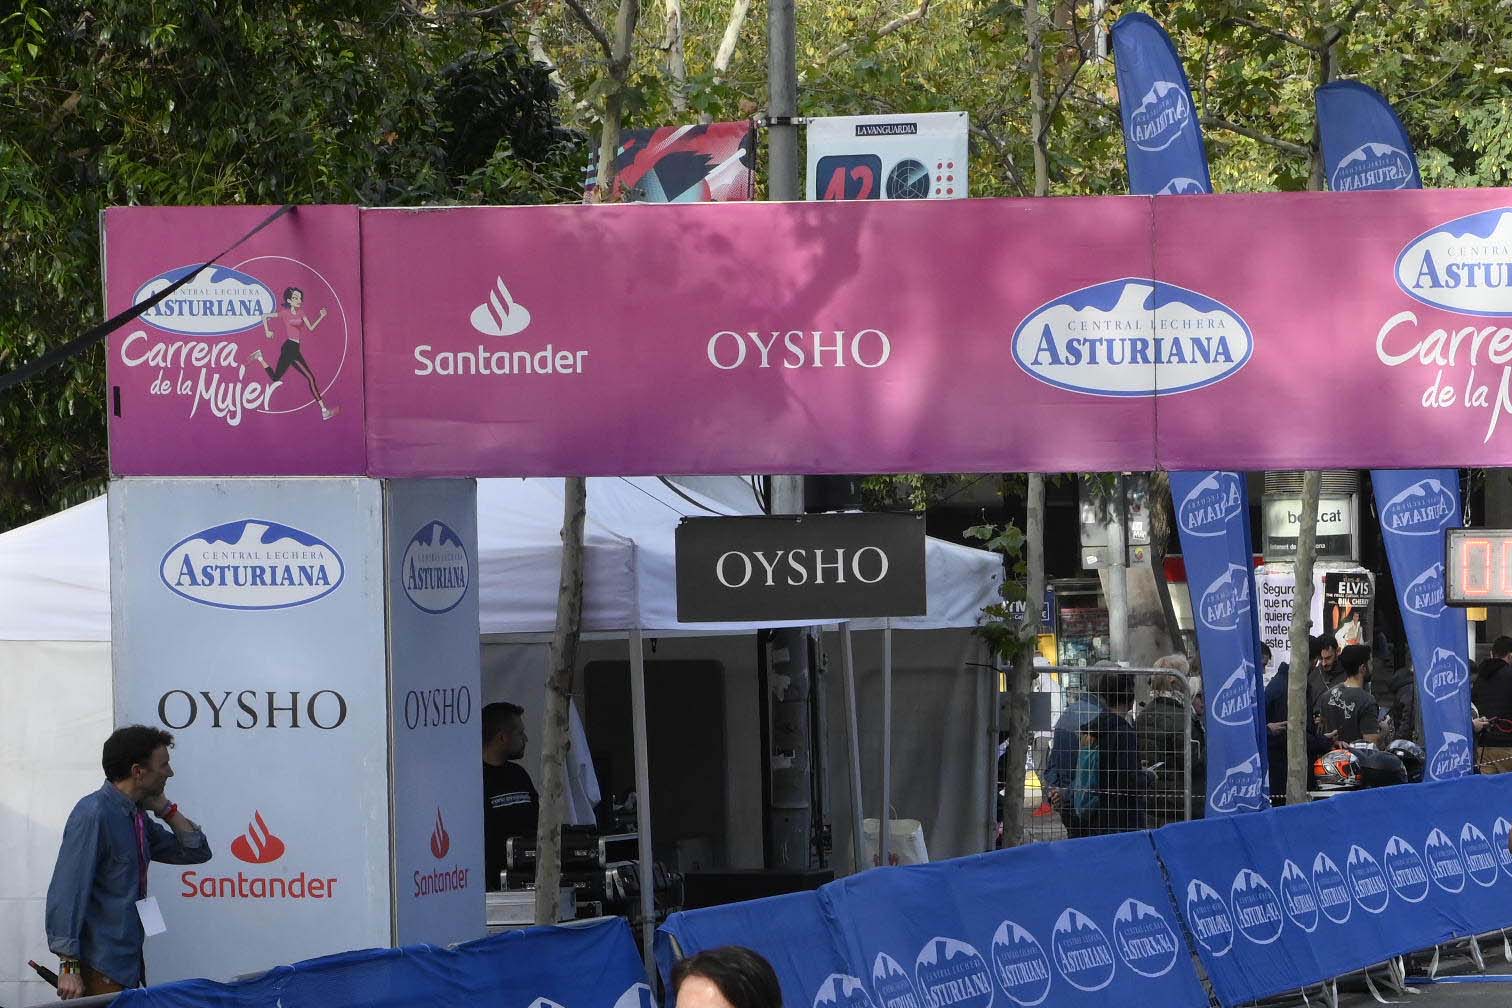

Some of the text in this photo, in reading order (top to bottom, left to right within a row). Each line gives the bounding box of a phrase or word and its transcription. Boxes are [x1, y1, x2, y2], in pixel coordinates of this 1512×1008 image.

[1068, 318, 1226, 331] CENTRAL LECHERA
[120, 331, 238, 367] Carrera
[414, 343, 589, 375] Santander
[707, 328, 891, 370] OYSHO
[1031, 323, 1234, 366] ASTURIANA
[150, 364, 283, 426] de la Mujer
[1421, 370, 1456, 408] de
[1464, 367, 1488, 408] la
[174, 552, 332, 587] ASTURIANA
[202, 550, 325, 561] CENTRAL LECHERA
[716, 545, 889, 588] OYSHO
[407, 555, 466, 591] ASTURIANA
[1338, 581, 1369, 595] ELVIS
[1263, 598, 1281, 608] que
[1264, 609, 1294, 625] quiere
[157, 689, 348, 729] OYSHO
[404, 685, 471, 730] OYSHO
[181, 870, 337, 898] Santander
[413, 864, 469, 898] Santander
[999, 956, 1048, 989] ASTURIANA
[1058, 941, 1112, 974] ASTURIANA
